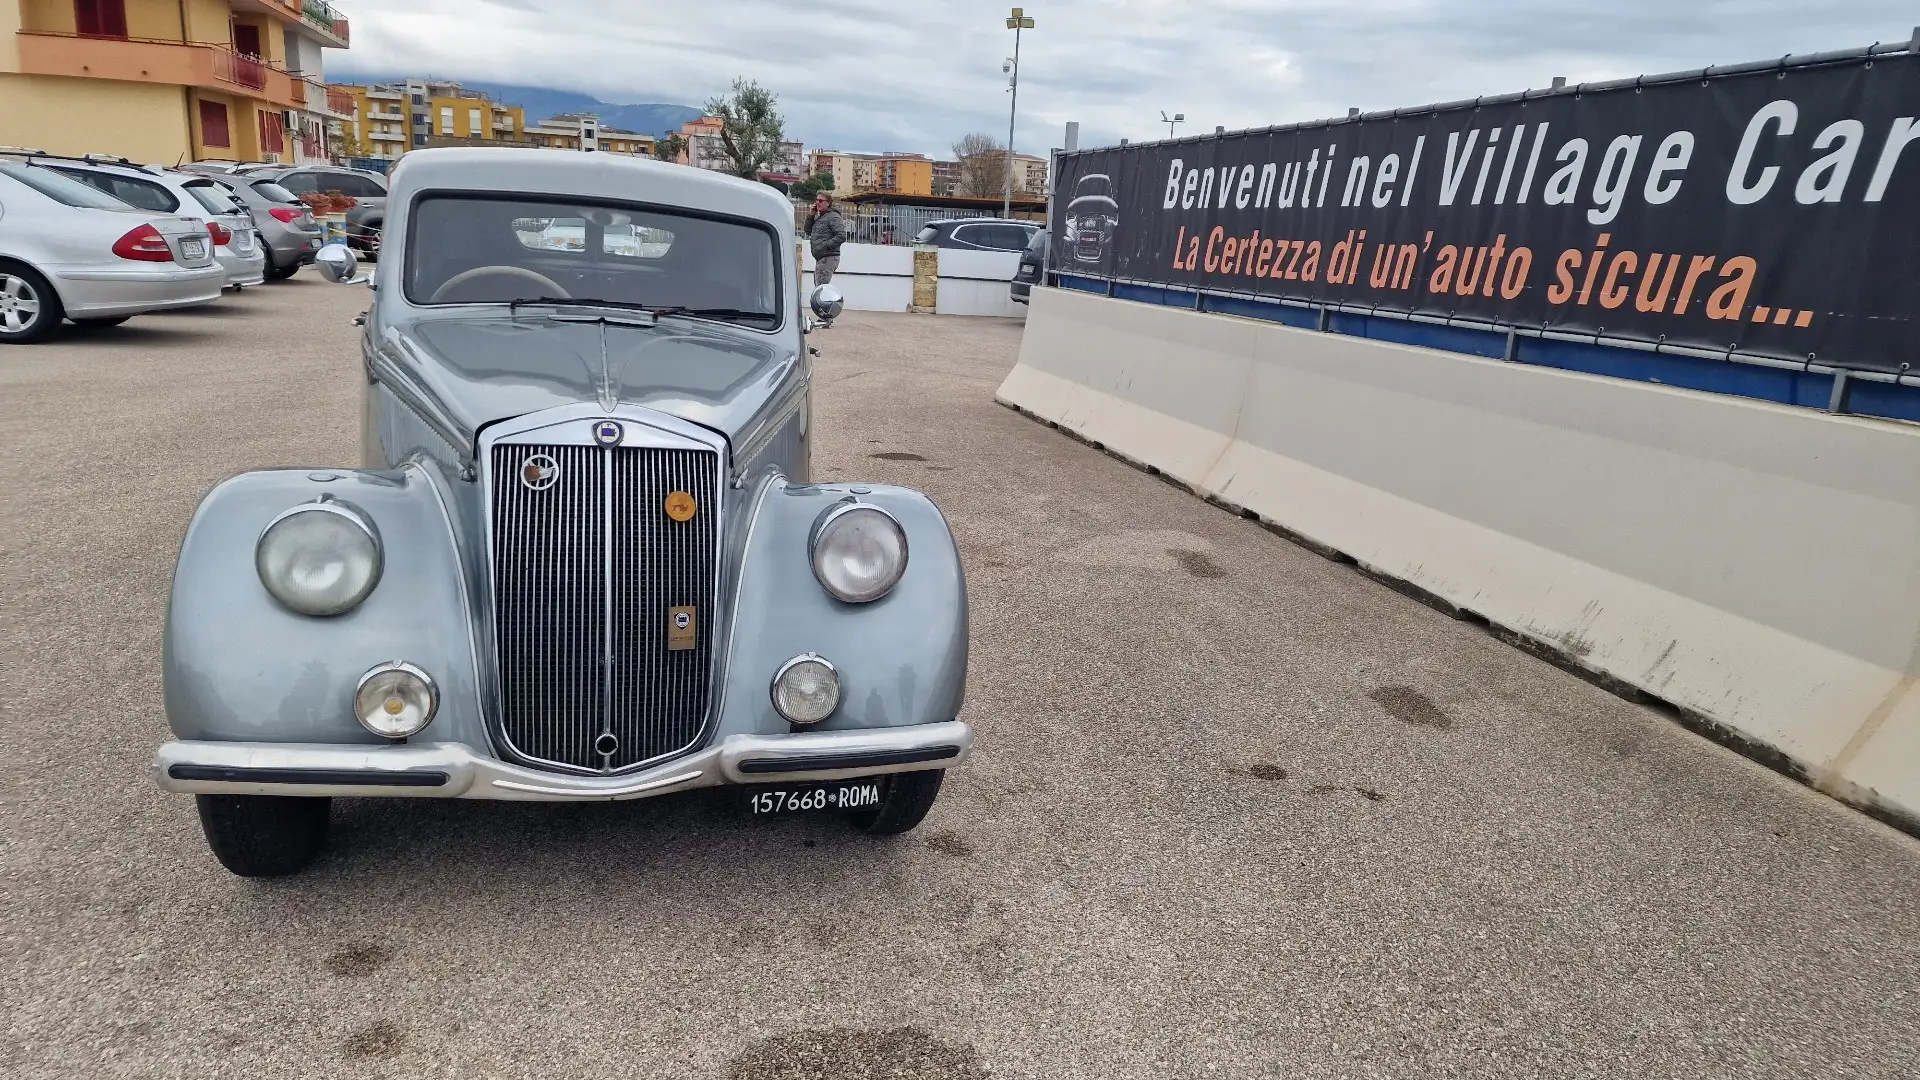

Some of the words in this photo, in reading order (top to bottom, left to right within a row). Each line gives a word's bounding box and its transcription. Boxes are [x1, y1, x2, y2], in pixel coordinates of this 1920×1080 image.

[1163, 143, 1337, 210] Benvenuti
[1341, 135, 1427, 208] nel
[1438, 121, 1696, 225] Village
[1173, 225, 1200, 271] La
[1204, 225, 1322, 282] Certezza
[1326, 229, 1367, 285] di
[1370, 230, 1533, 300] un'auto
[1547, 233, 1814, 328] sicura...
[751, 789, 826, 814] 157668
[838, 784, 879, 808] ROMA
